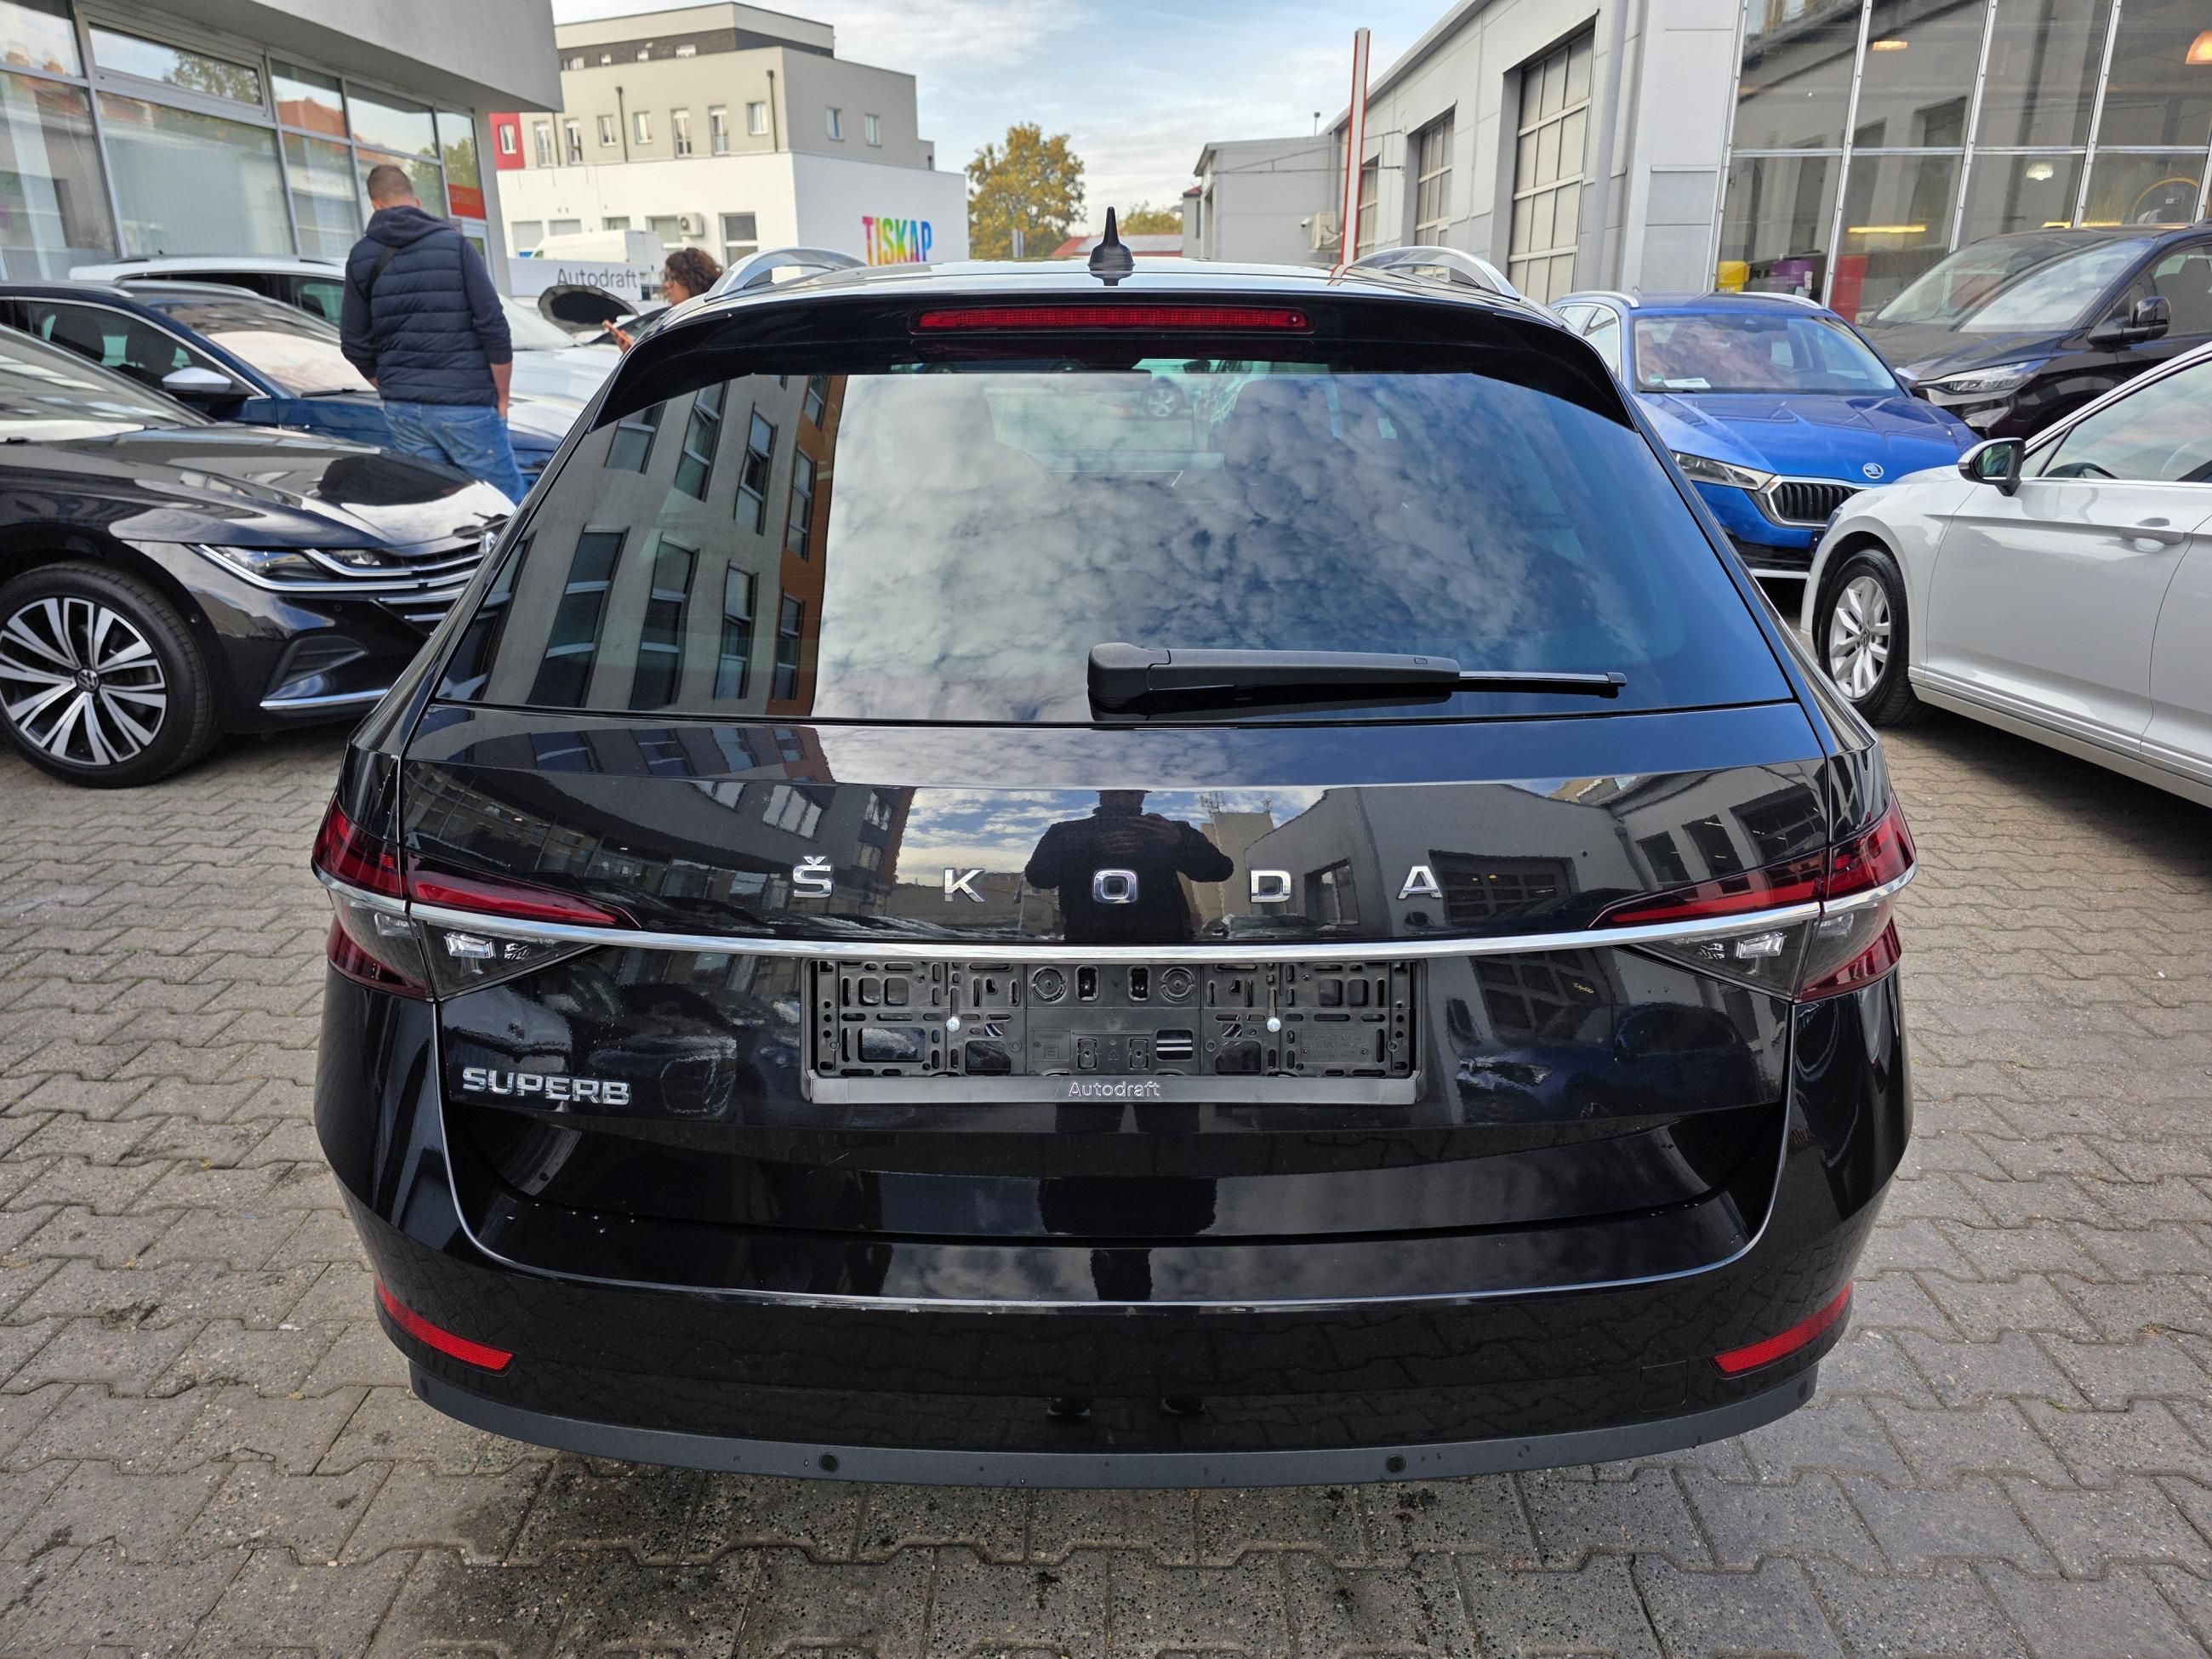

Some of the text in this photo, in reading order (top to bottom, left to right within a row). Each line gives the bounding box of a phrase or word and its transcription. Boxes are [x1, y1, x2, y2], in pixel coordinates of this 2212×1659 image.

[862, 216, 932, 266] TISKAP
[558, 268, 637, 288] Autodraft
[792, 856, 1443, 904] ŠKODA
[463, 1068, 630, 1105] SUPERB
[1069, 1081, 1160, 1097] Autodraft
